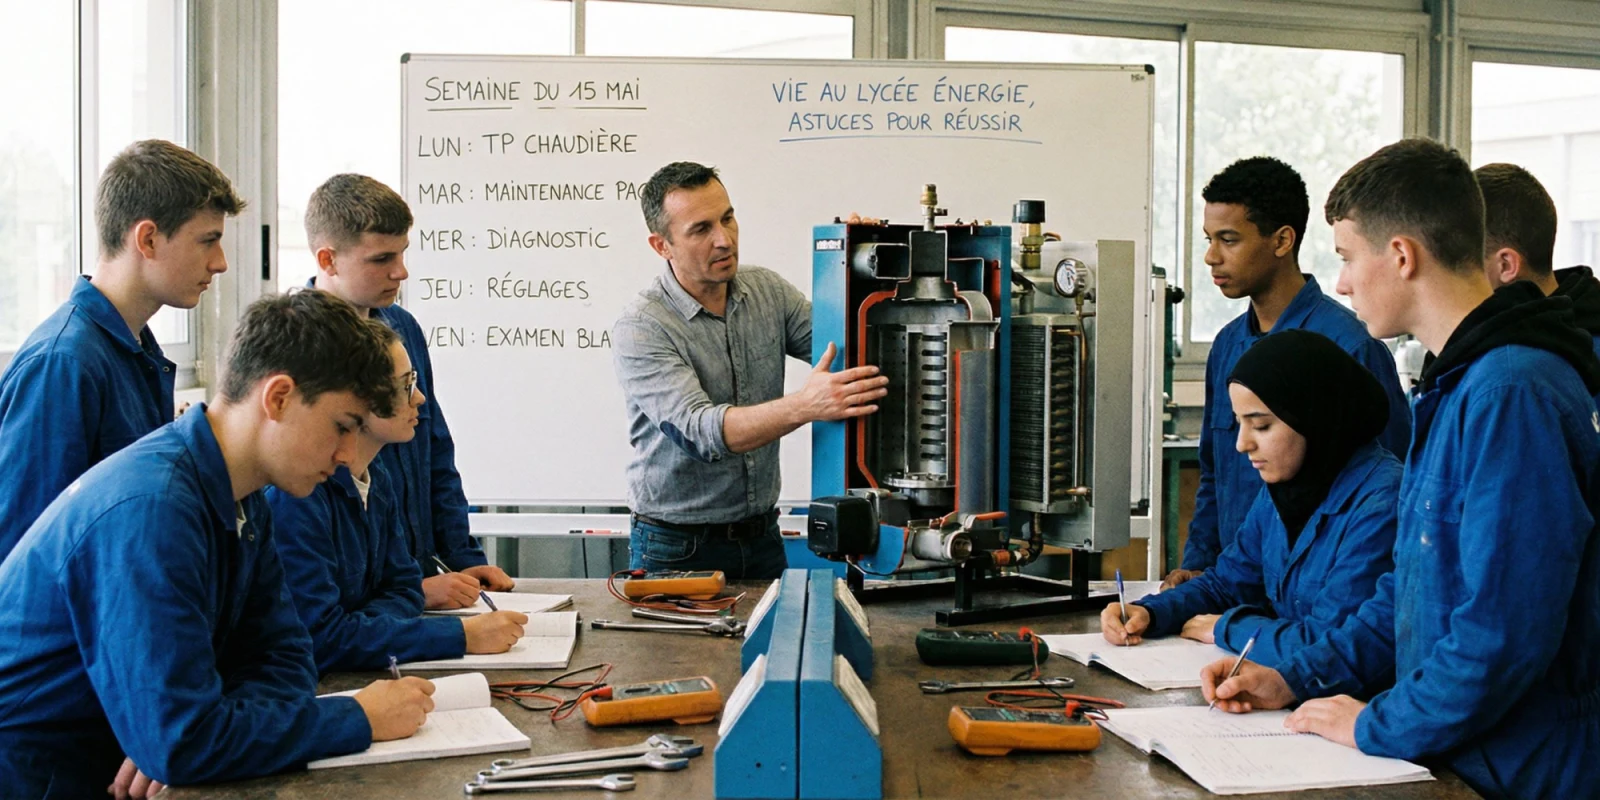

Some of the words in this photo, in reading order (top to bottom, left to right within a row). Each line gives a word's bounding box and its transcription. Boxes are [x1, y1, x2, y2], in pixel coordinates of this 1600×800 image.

[424, 76, 521, 102] SEMAINE
[533, 81, 560, 101] DU
[568, 80, 597, 101] 15
[606, 77, 640, 101] MAI
[772, 77, 809, 103] VIE
[820, 81, 847, 102] AU
[857, 76, 920, 104] LYCÉE
[933, 75, 1035, 109] ÉNERGIE,
[788, 111, 874, 133] ASTUCES
[887, 111, 933, 131] POUR
[944, 108, 1023, 133] RÉUSSIR
[481, 132, 515, 155] TP
[523, 127, 638, 155] CHAUDIÈRE
[484, 179, 605, 202] MAINTENANCE
[486, 226, 610, 250] DIAGNOSTIC
[487, 271, 590, 300] RÉGLAGES
[486, 325, 565, 348] EXAMEN
